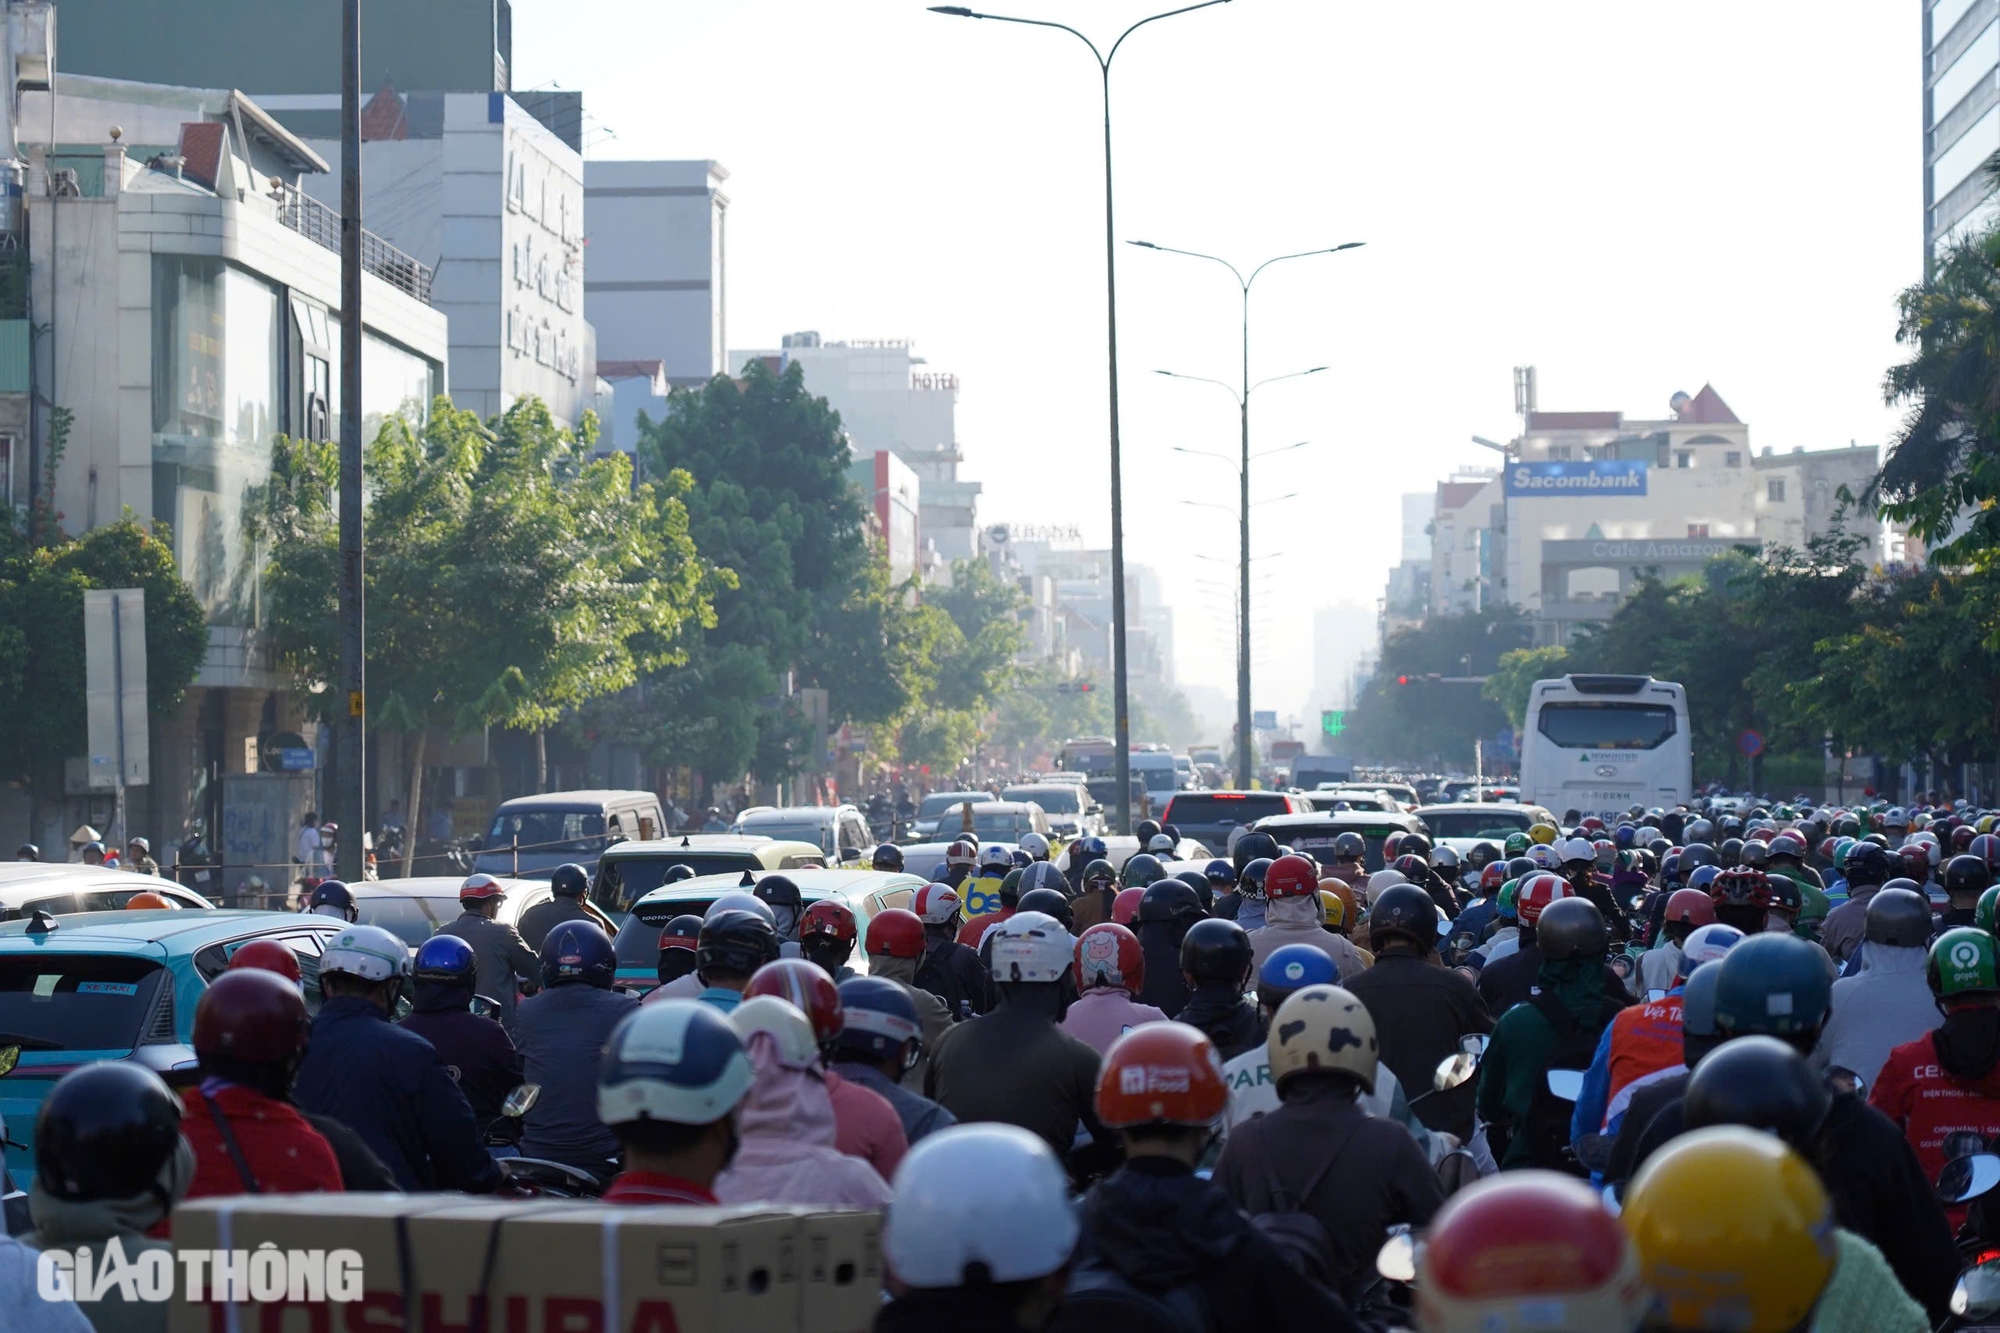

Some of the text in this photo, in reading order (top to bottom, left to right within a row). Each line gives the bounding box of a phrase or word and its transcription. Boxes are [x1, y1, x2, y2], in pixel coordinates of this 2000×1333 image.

[912, 372, 957, 391] HOTEL
[1513, 467, 1640, 489] Sacombank
[1645, 541, 1726, 557] Amazon
[966, 881, 1001, 915] be
[1953, 970, 1980, 982] gojek
[86, 983, 131, 992] XE TAXI
